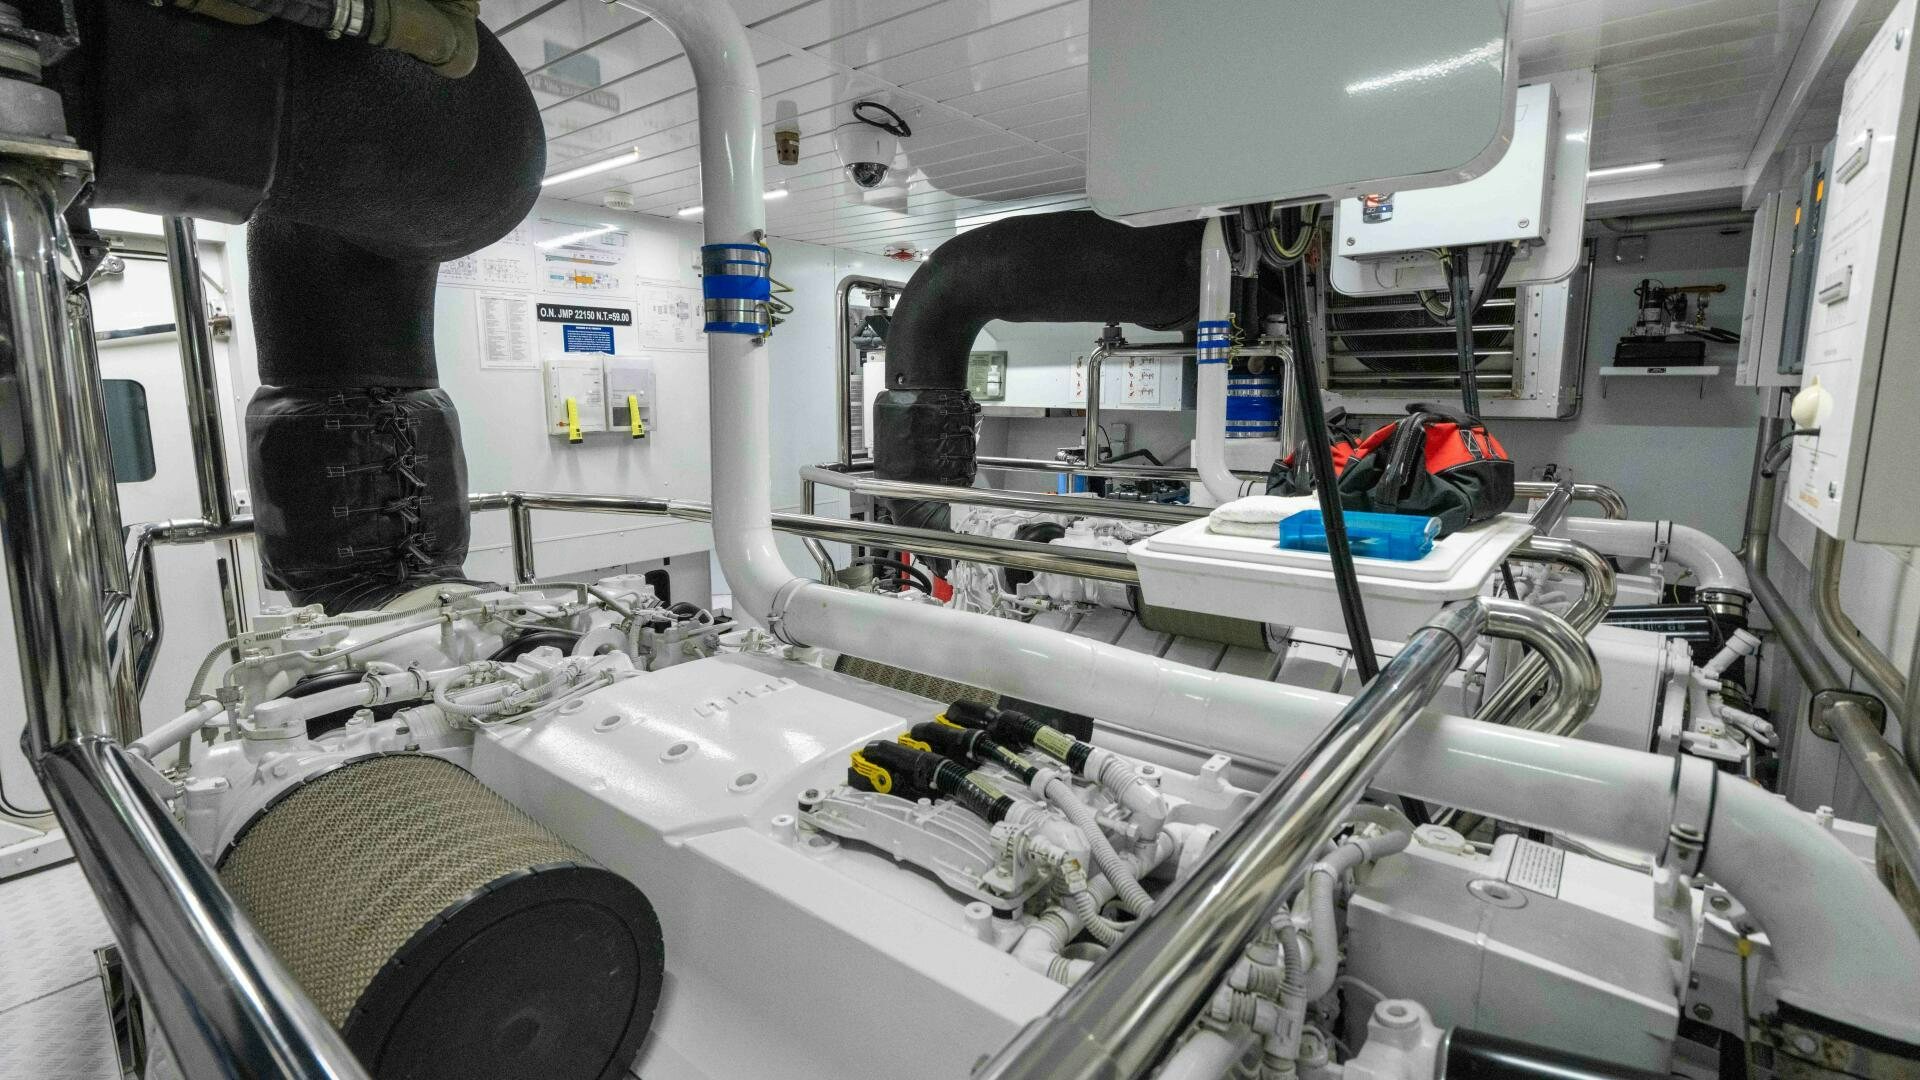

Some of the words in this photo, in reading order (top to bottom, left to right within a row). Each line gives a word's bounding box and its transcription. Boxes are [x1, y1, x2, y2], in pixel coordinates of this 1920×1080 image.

[540, 307, 556, 317] O.N.
[558, 309, 573, 319] JMP
[574, 310, 595, 320] 22150
[596, 311, 630, 322] N.T.=59.00
